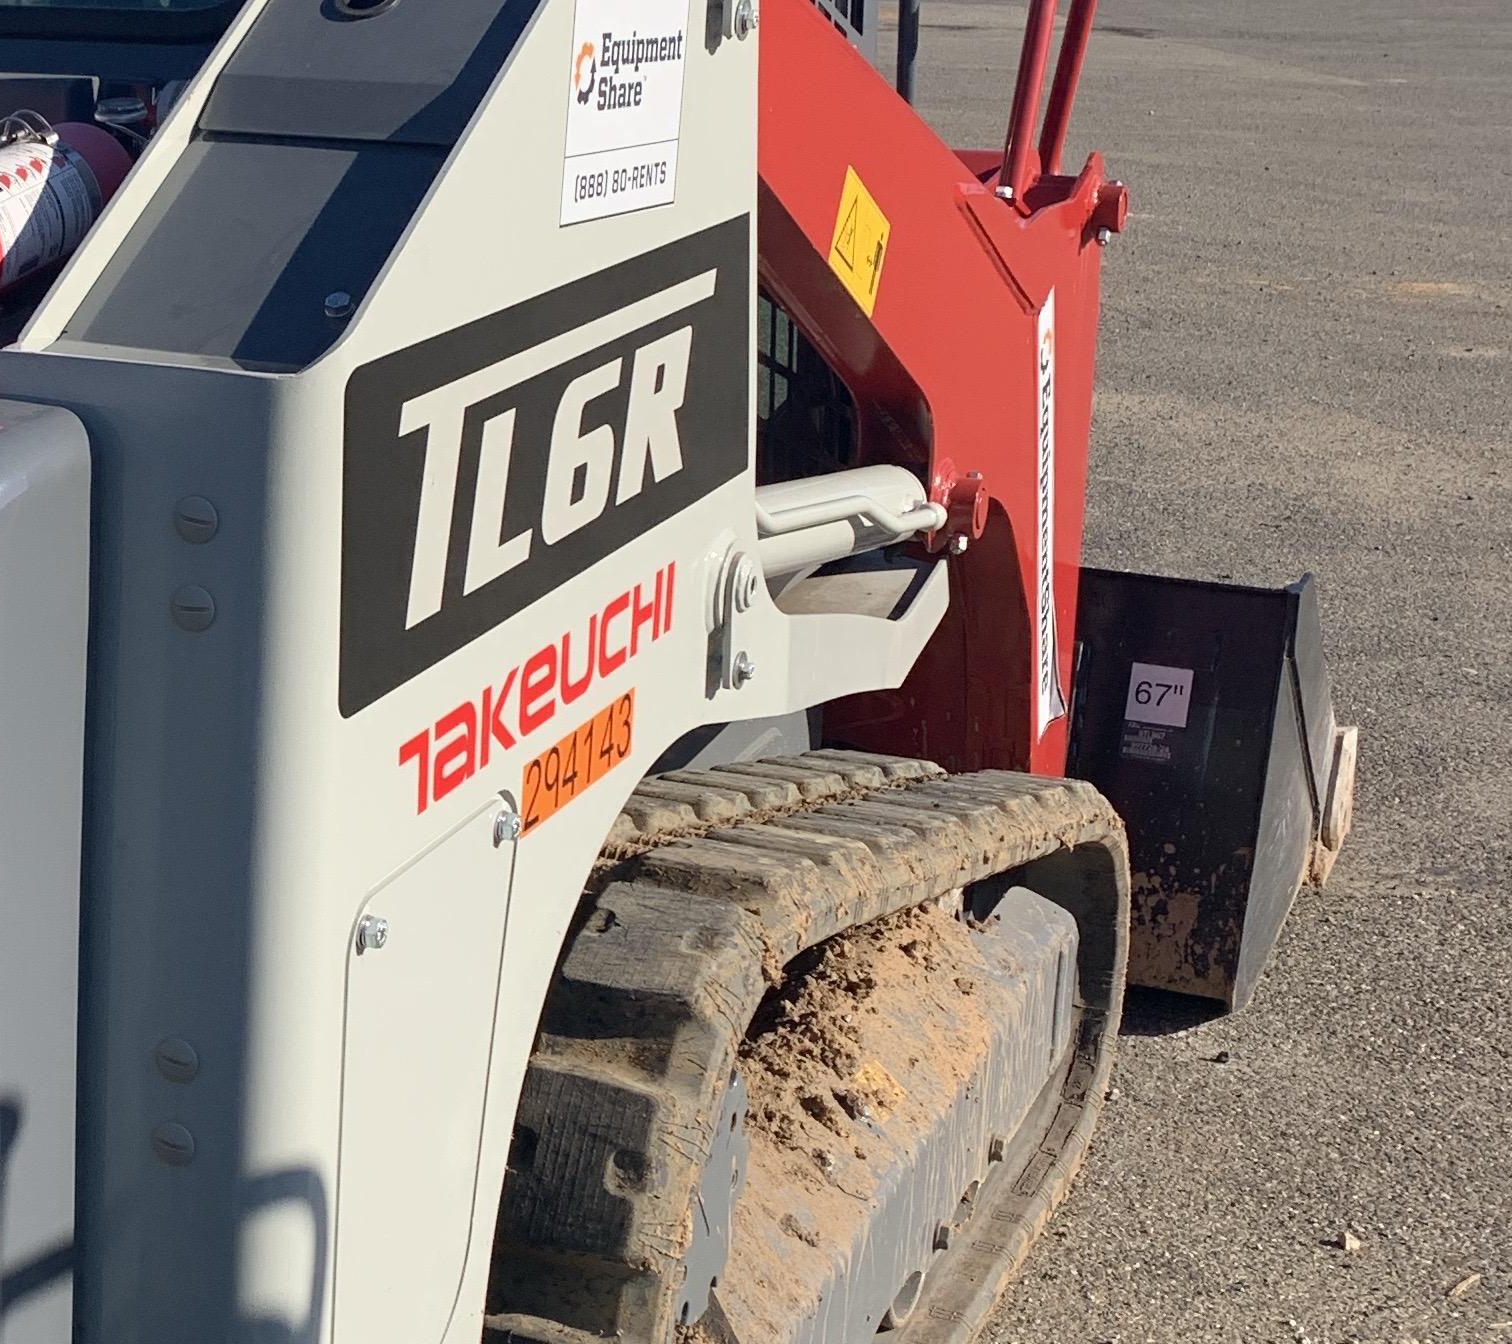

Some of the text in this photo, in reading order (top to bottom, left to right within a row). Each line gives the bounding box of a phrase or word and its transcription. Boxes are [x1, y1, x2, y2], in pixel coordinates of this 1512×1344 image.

[599, 30, 683, 74] Equipment
[597, 76, 643, 111] Share
[574, 170, 609, 203] (888)
[397, 267, 718, 631] TL6R
[1134, 680, 1185, 707] 67"
[523, 692, 633, 832] 294143
